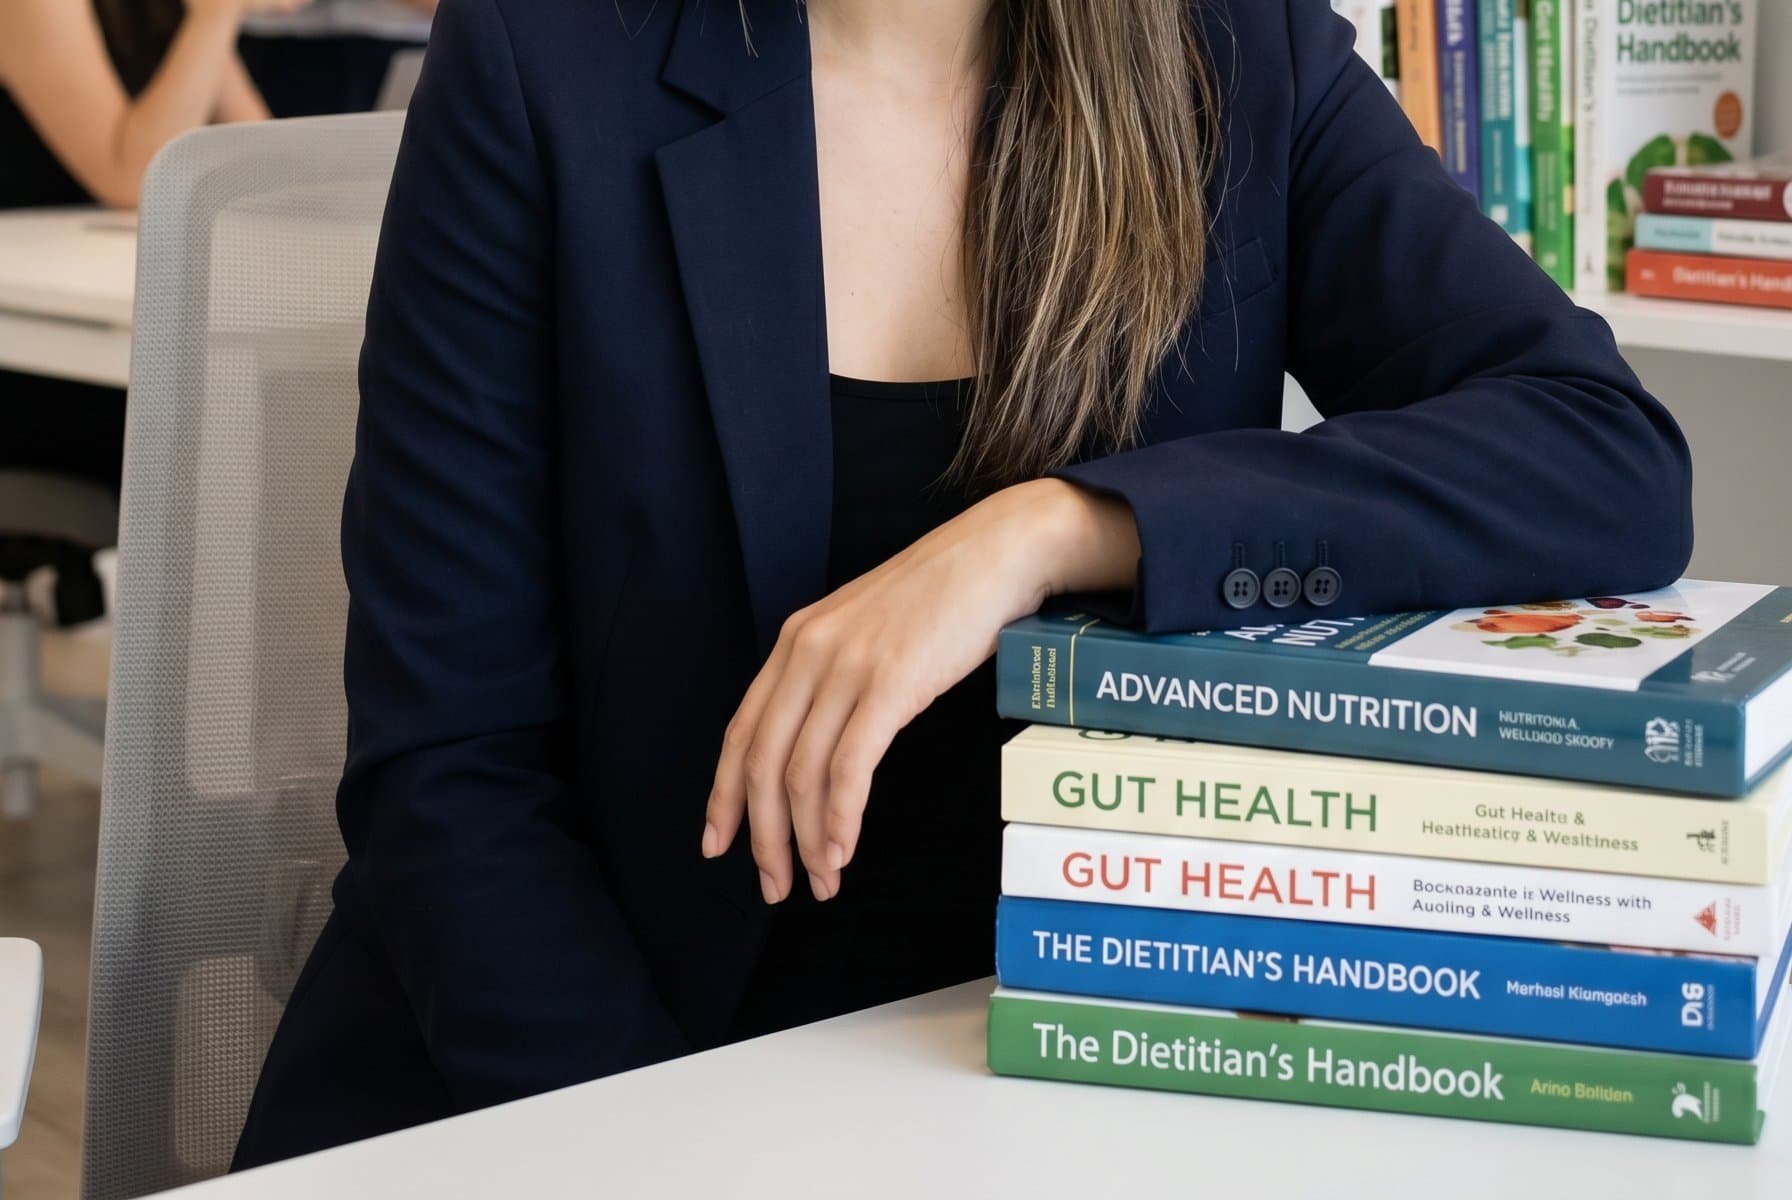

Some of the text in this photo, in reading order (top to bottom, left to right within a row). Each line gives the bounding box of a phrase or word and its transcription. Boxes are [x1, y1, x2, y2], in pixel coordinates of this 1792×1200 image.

[1616, 32, 1741, 64] Handbook
[1096, 671, 1279, 716] ADVANCED
[1288, 690, 1477, 738] NUTRITION
[1052, 771, 1377, 832] GUT HEALTH
[1475, 804, 1504, 819] Gut
[1574, 812, 1584, 825] &
[1527, 830, 1537, 842] &
[1062, 852, 1376, 911] GUT HEALTH
[1540, 889, 1611, 906] Wellness
[1617, 895, 1651, 910] with
[1482, 904, 1491, 917] &
[1499, 906, 1570, 923] Wellness
[1033, 930, 1480, 999] THE DIETITIAN'S HANDBOOK
[1033, 1023, 1504, 1100] The Dietitian's Handbook
